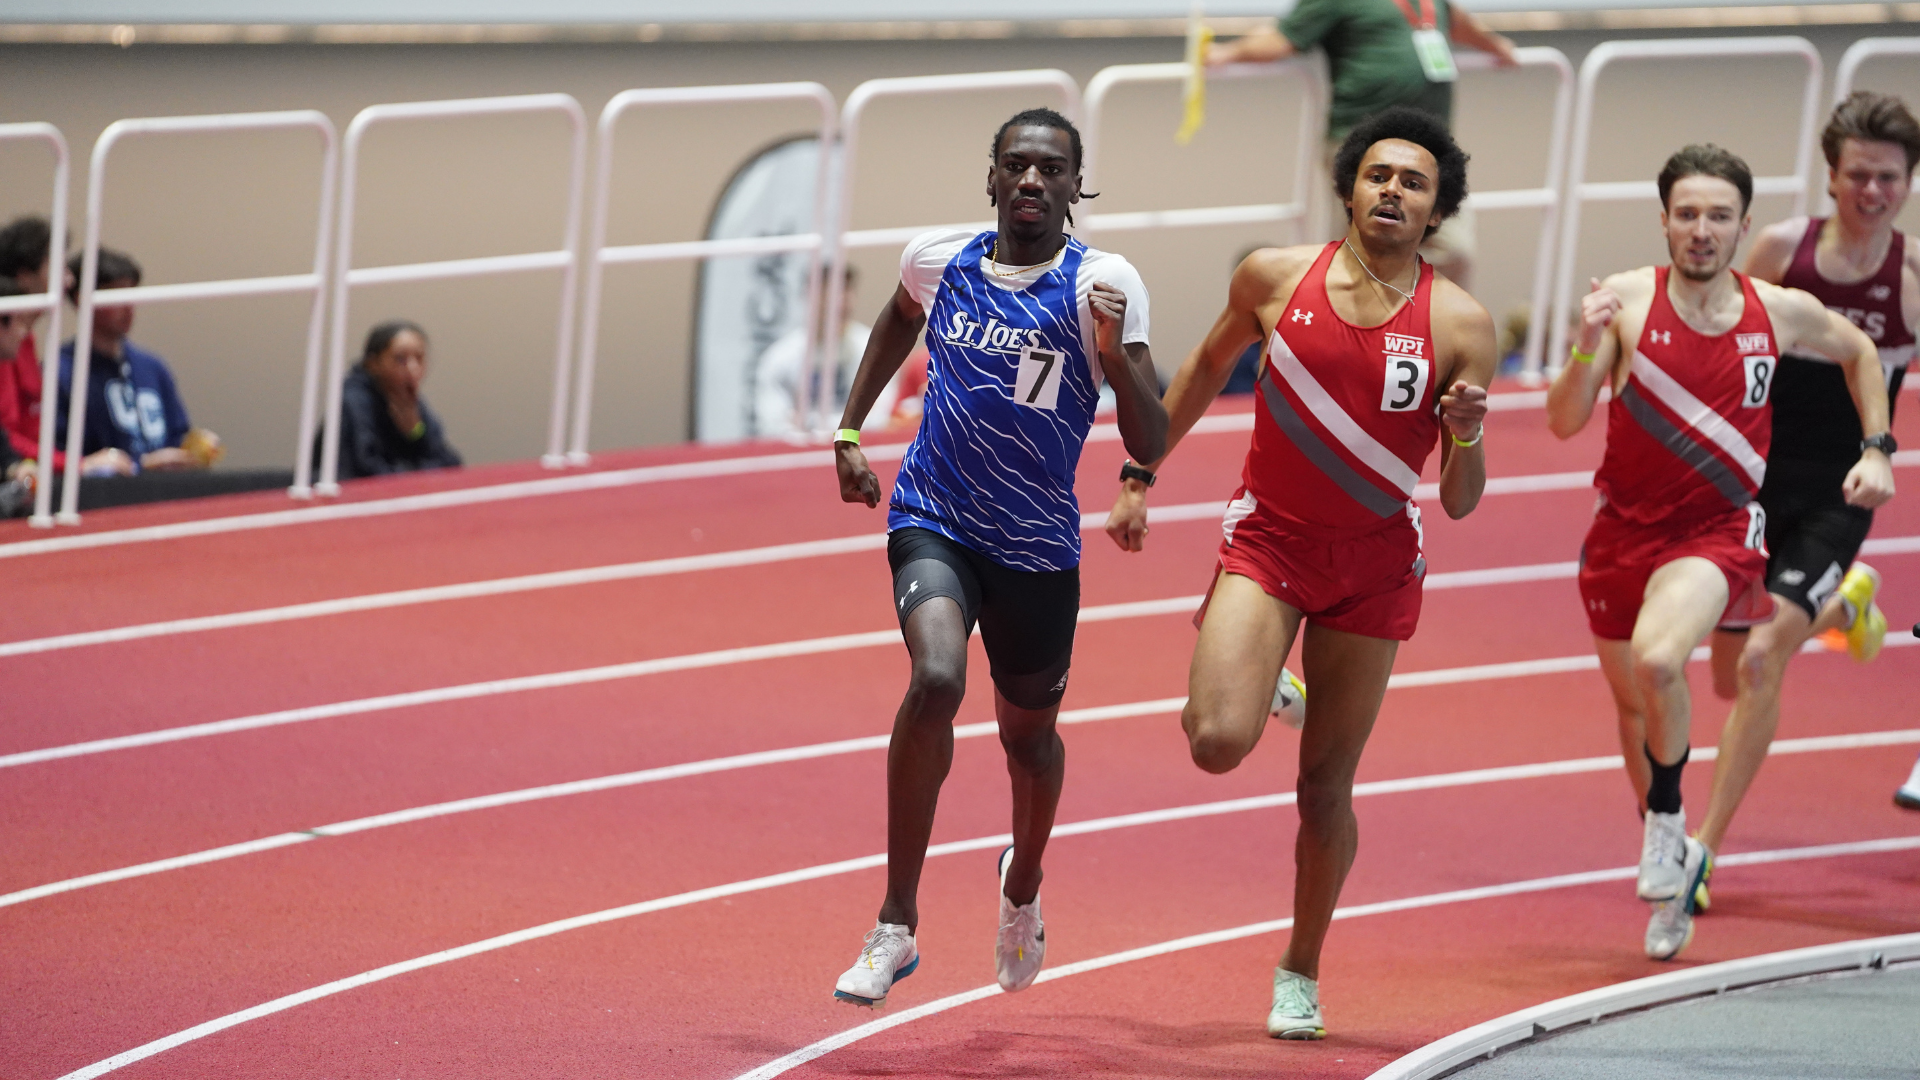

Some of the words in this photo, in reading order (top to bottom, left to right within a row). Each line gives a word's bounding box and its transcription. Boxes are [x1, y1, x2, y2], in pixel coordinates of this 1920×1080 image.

[1384, 336, 1424, 355] WPI
[1735, 335, 1769, 349] WPI
[1025, 351, 1056, 404] 7
[1390, 360, 1419, 409] 3
[1751, 361, 1768, 403] 8
